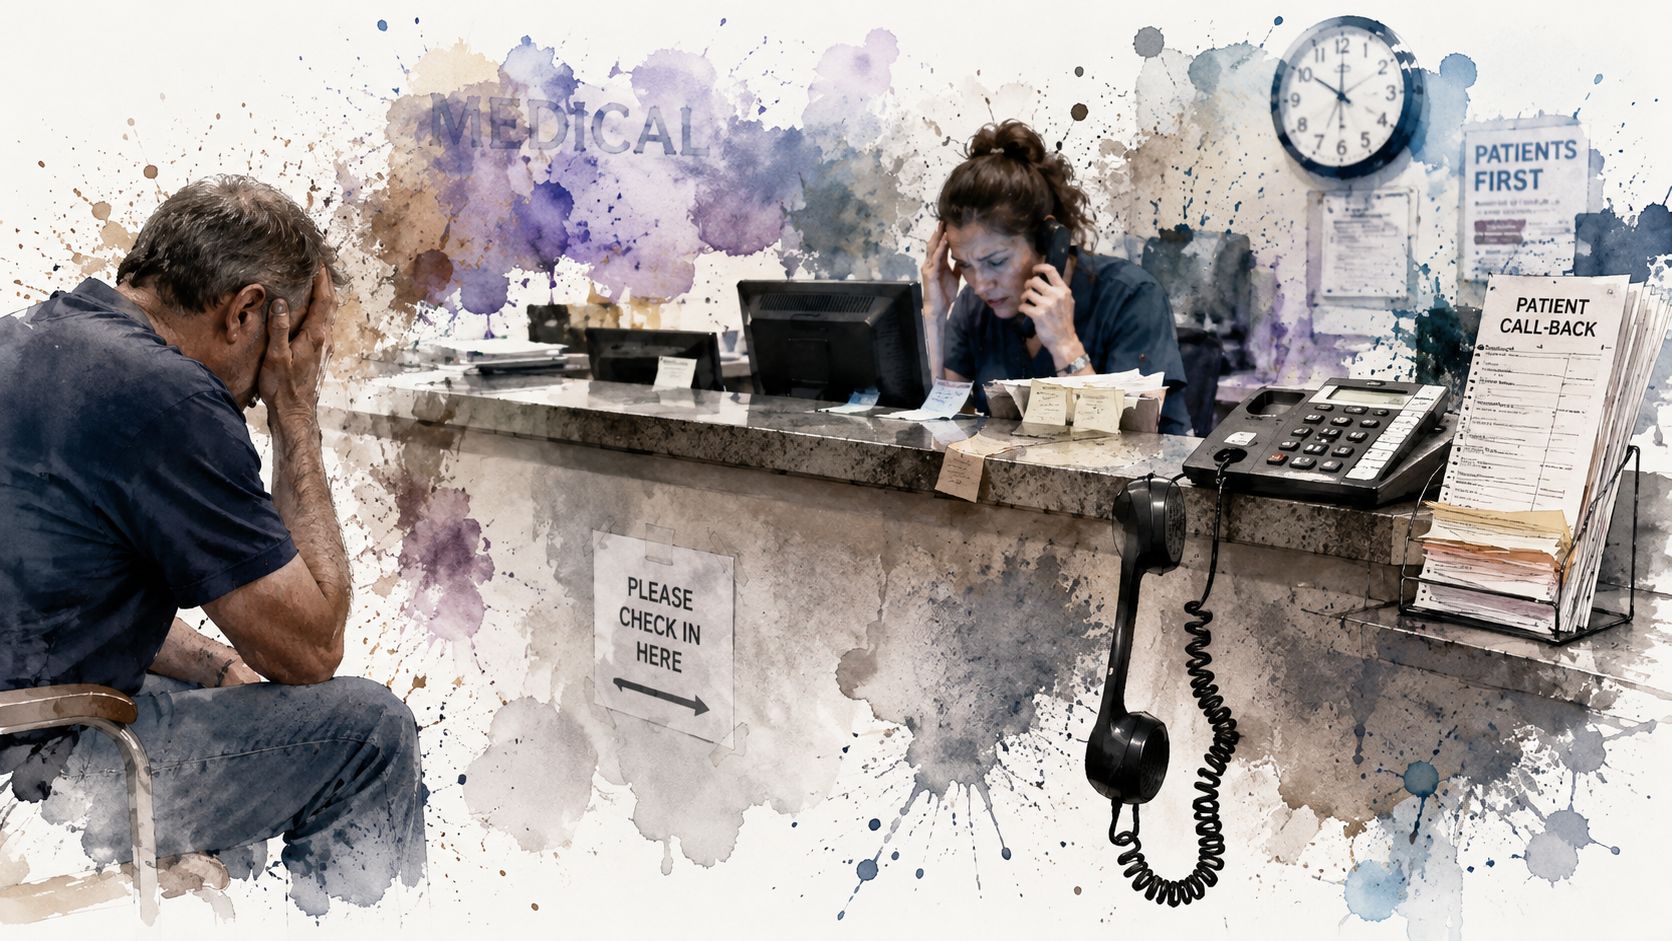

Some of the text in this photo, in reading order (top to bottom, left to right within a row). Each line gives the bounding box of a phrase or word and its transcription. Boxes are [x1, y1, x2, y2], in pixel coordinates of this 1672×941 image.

[1335, 37, 1350, 54] 12
[1363, 42, 1368, 58] 1
[1315, 47, 1325, 63] 11
[1298, 67, 1312, 83] 10
[1377, 59, 1388, 75] 2
[1290, 92, 1300, 108] 9
[1385, 85, 1396, 101] 3
[430, 92, 710, 156] MEDICAL
[1297, 117, 1308, 133] 8
[1377, 112, 1388, 127] 4
[1314, 134, 1324, 150] 7
[1336, 140, 1347, 155] 6
[1360, 132, 1371, 148] 5
[1475, 139, 1577, 165] PATIENTS
[1474, 168, 1543, 192] FIRST
[1516, 297, 1590, 314] PATIENT
[1500, 318, 1597, 337] CALL-BACK
[628, 576, 693, 611] PLEASE
[619, 606, 700, 645] CHECK IN
[637, 641, 682, 673] HERE
